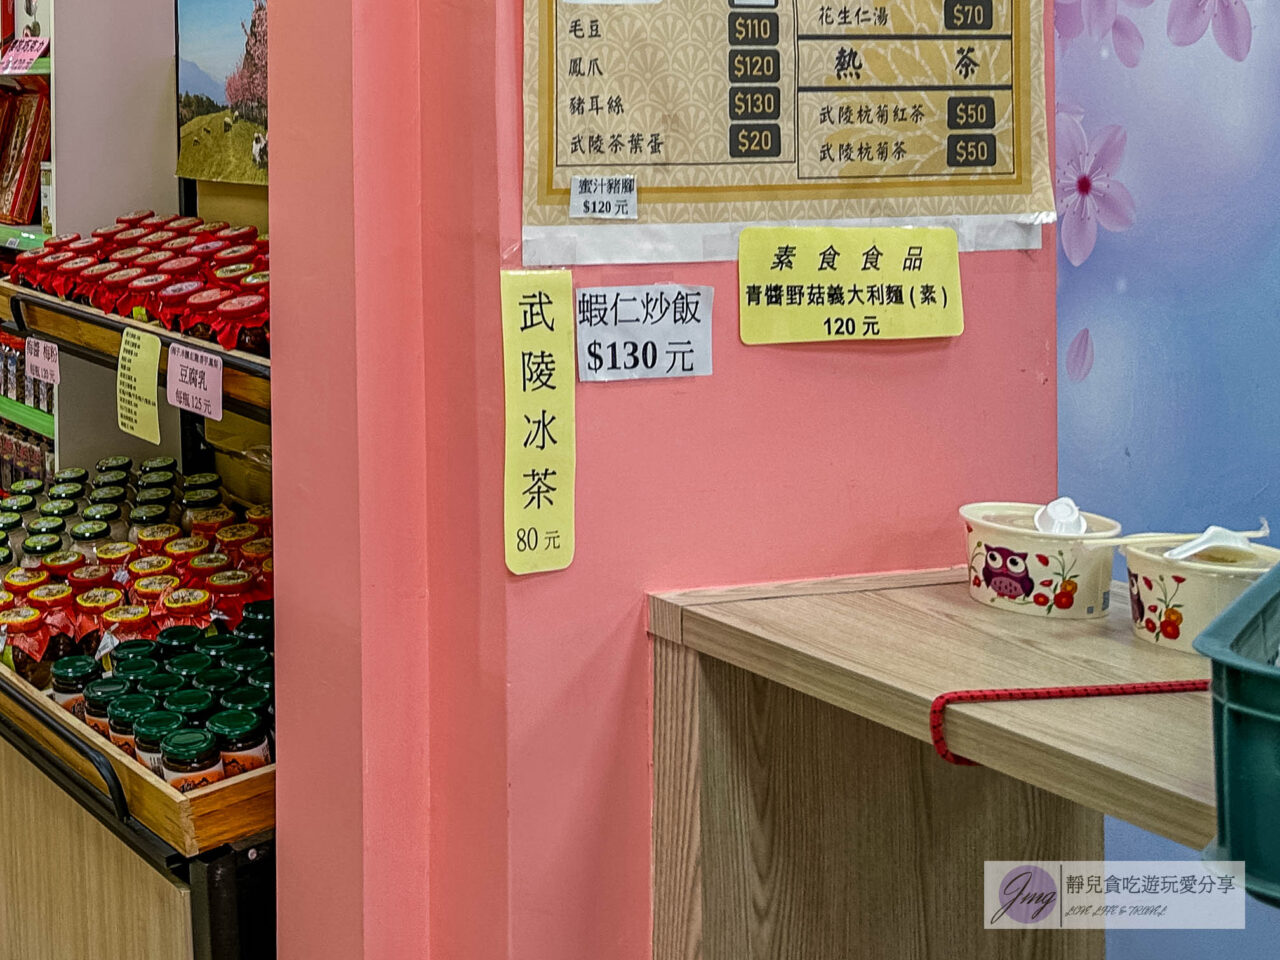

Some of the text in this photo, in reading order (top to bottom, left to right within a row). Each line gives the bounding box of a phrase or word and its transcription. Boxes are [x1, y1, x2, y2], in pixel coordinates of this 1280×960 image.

[818, 5, 889, 27] 花生仁湯
[953, 5, 984, 26] $70
[568, 18, 602, 40] 毛豆
[735, 18, 771, 40] $110
[568, 56, 604, 78] 鳳爪
[733, 55, 774, 77] $120
[568, 94, 625, 116] 豬耳絲
[734, 92, 774, 115] $130
[819, 103, 925, 126] 武陵杭菊紅茶
[955, 103, 987, 125] $50
[569, 133, 665, 155] 武陵茶葉蛋
[737, 130, 772, 153] $20
[819, 140, 908, 163] 武陵杭菊茶
[955, 140, 988, 163] $50
[578, 289, 702, 328] 蝦仁炒飯
[178, 364, 208, 392] 豆腐乳
[518, 289, 557, 512] 武陵冰茶
